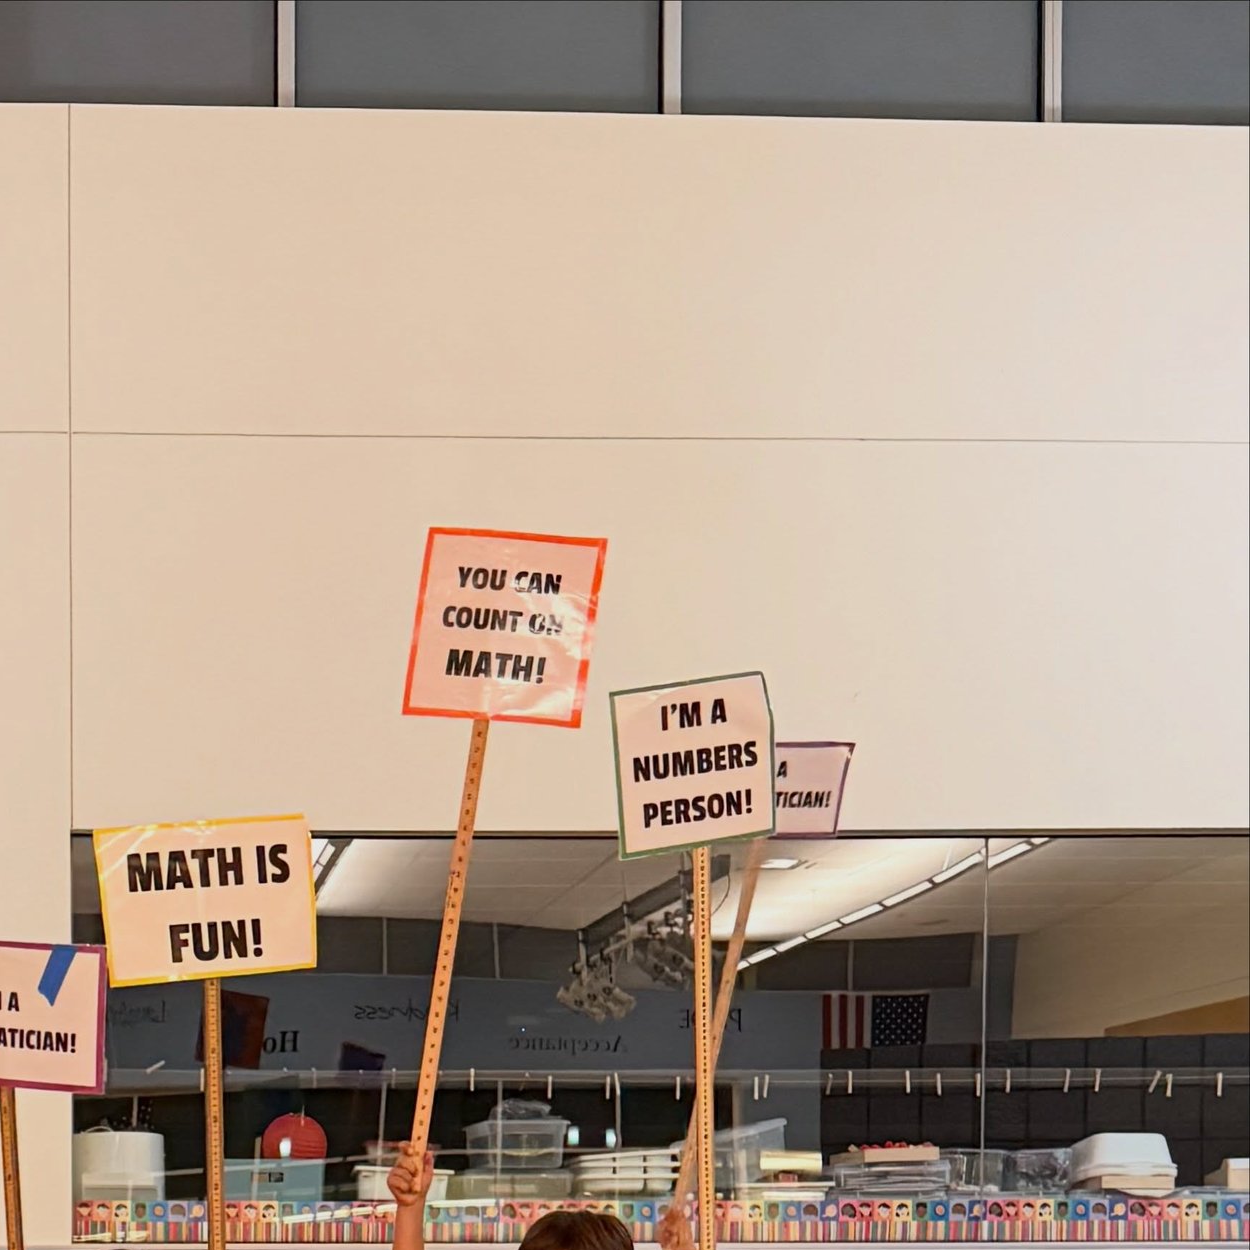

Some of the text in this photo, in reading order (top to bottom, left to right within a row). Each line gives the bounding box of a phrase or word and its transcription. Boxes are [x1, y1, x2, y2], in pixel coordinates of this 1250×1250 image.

[458, 566, 562, 595] YOU CAN
[442, 605, 564, 636] COUNT ON
[445, 648, 547, 684] MATH!
[661, 698, 727, 731] I'M A
[633, 740, 758, 782] NUMBERS
[776, 760, 788, 778] A
[643, 788, 753, 828] PERSON!
[775, 790, 832, 809] TICIAN!
[126, 843, 291, 892] MATH IS
[169, 918, 263, 963] FUN!
[7, 990, 20, 1012] A
